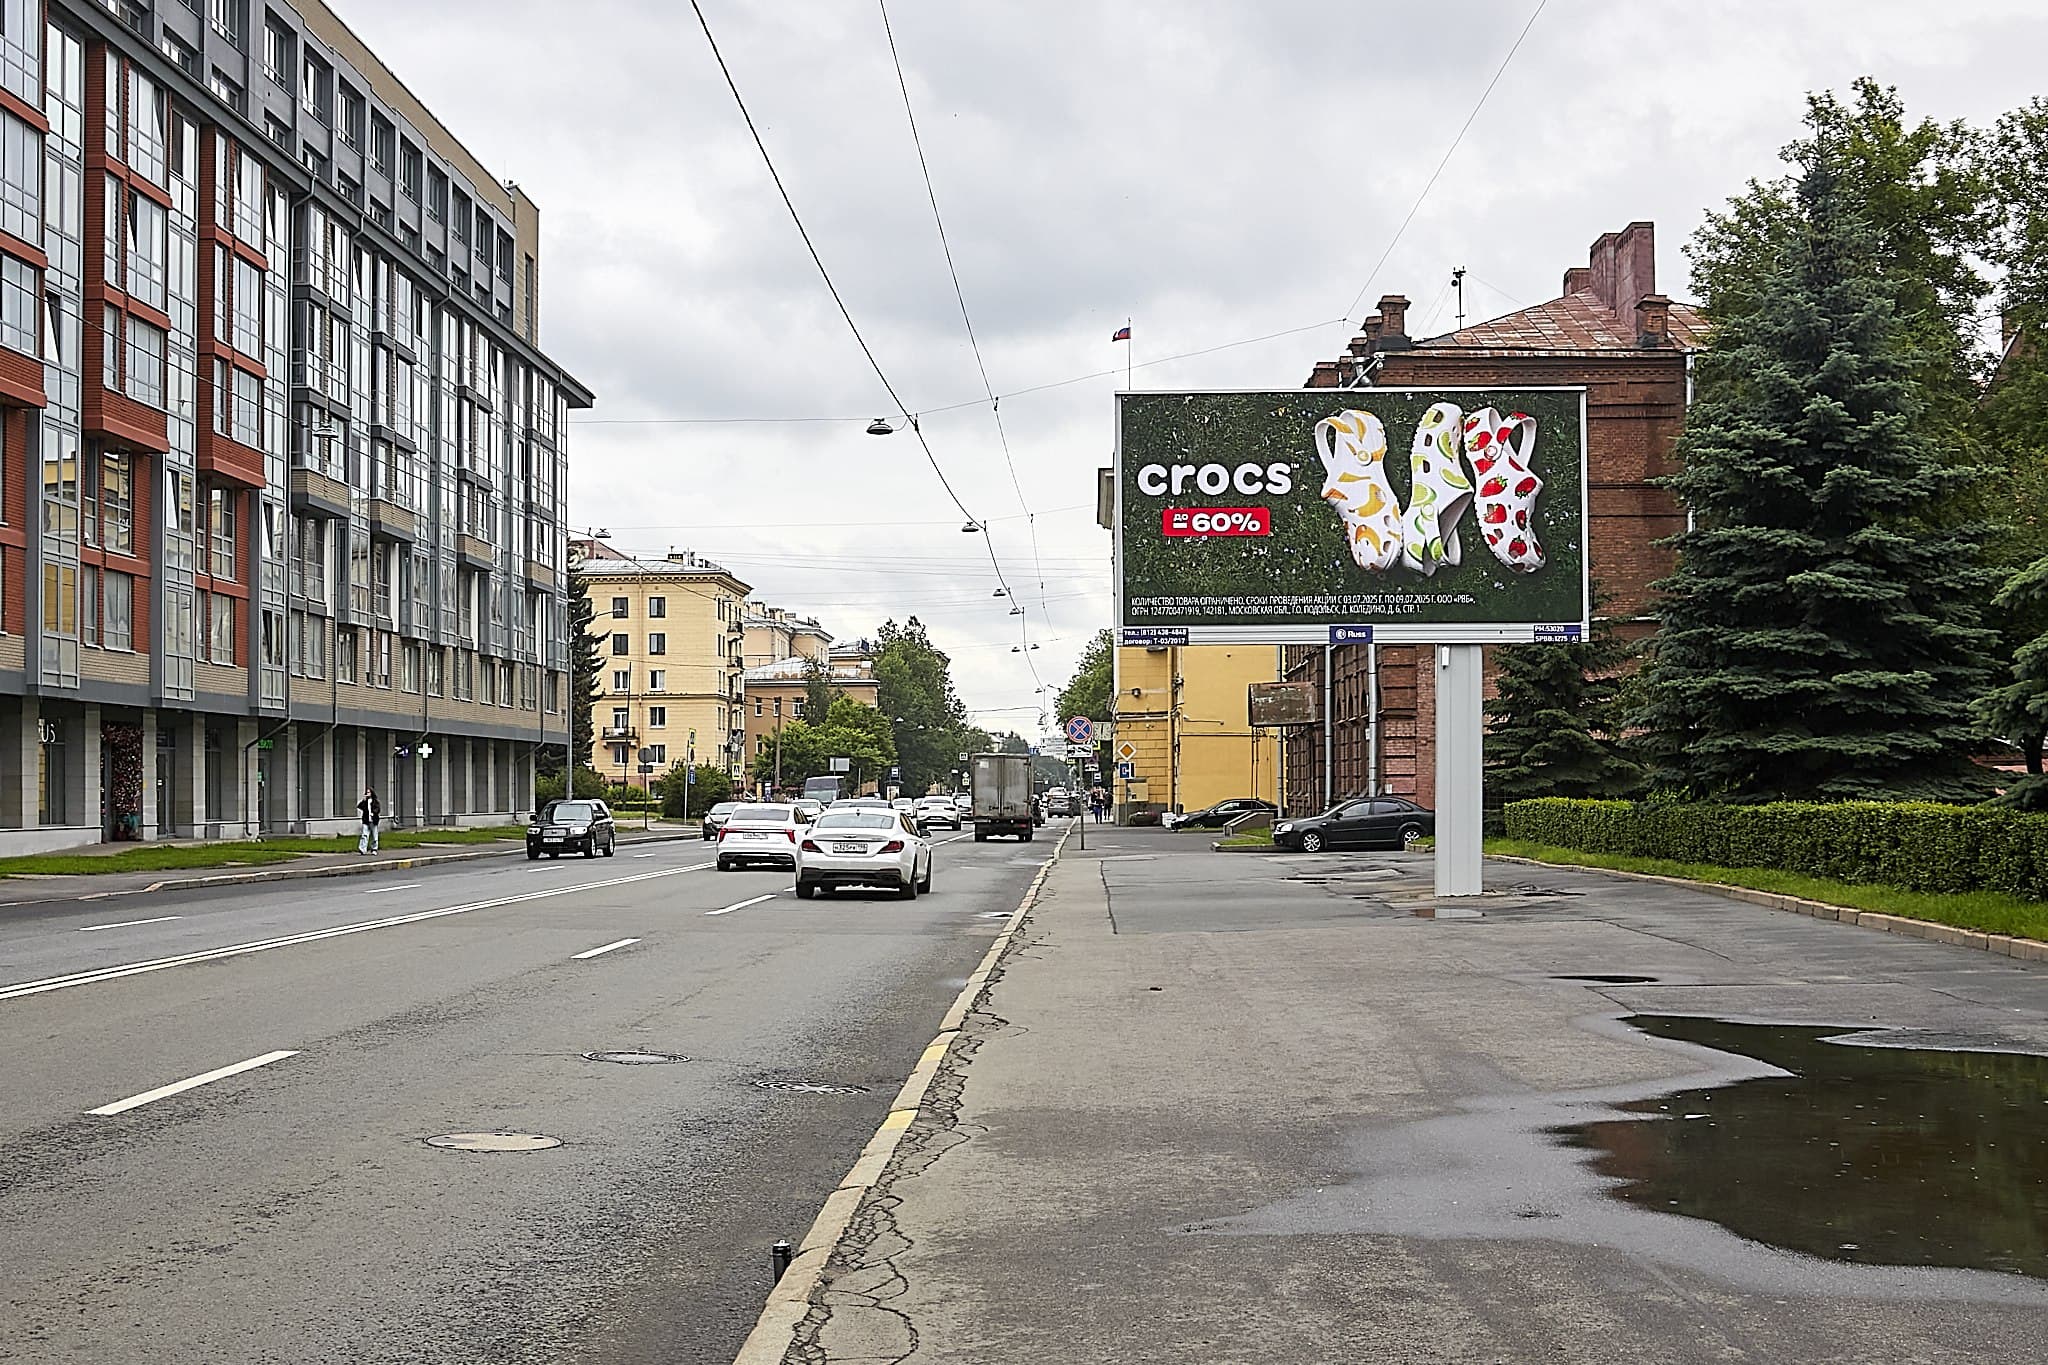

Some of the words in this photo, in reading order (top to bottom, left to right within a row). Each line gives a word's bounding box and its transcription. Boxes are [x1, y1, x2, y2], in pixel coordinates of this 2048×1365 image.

[1137, 462, 1292, 496] crocs
[1131, 596, 1174, 606] КОЛИЧЕСТВО
[1175, 596, 1200, 606] ТОВАРА
[1245, 595, 1268, 605] СРОКИ
[1269, 595, 1312, 606] ПРОВЕДЕНИЯ
[1314, 595, 1337, 605] АКЦИИ
[1338, 595, 1343, 604] С
[1343, 595, 1378, 604] 03.07.2025
[1384, 594, 1395, 604] ПО
[1395, 594, 1431, 604] 09.07.2025
[1437, 594, 1453, 604] ООО
[1131, 606, 1149, 616] ОГРН
[1228, 605, 1273, 615] МОСКОВСКАЯ
[1347, 630, 1367, 638] Russ
